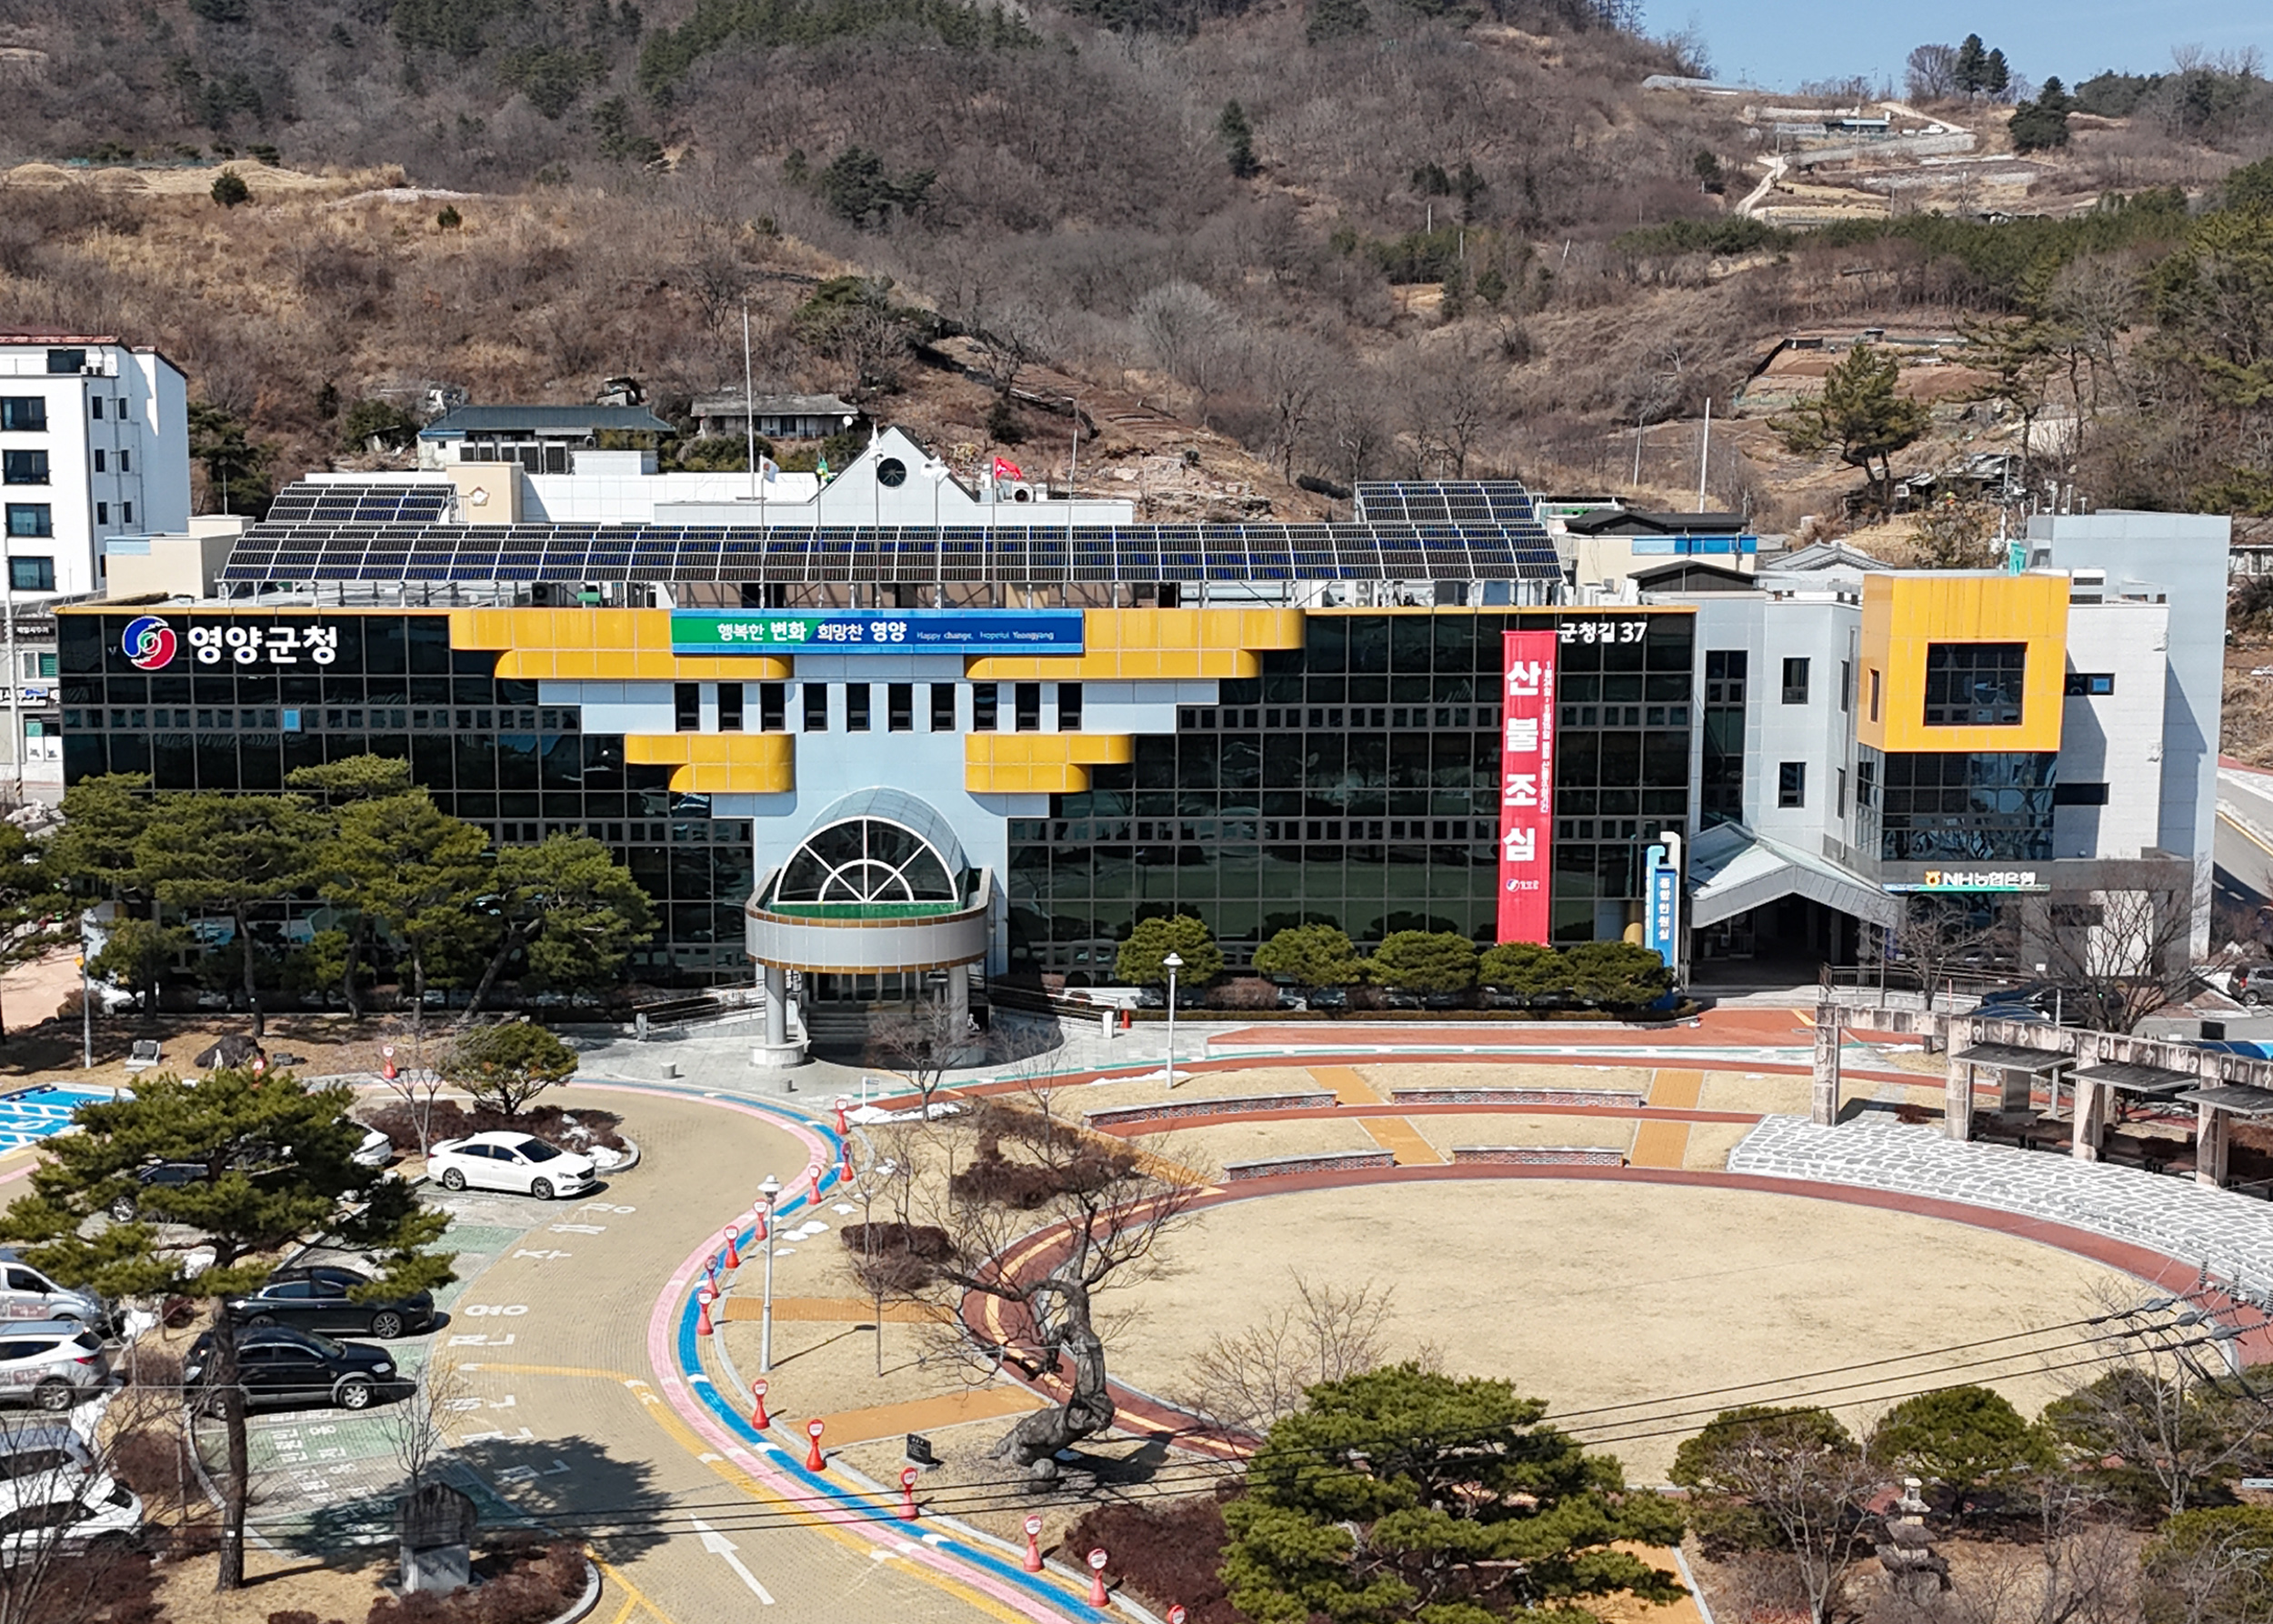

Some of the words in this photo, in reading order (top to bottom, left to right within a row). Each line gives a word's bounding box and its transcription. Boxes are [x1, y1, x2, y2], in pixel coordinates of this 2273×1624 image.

[187, 626, 338, 665] 영양군청
[717, 623, 765, 641] 행복한
[770, 621, 807, 642] 변화
[817, 623, 864, 642] 희망찬
[870, 621, 907, 642] 영양
[1558, 622, 1615, 643] 군청길
[1620, 622, 1647, 642] 37
[1503, 661, 1543, 862] 산불조심
